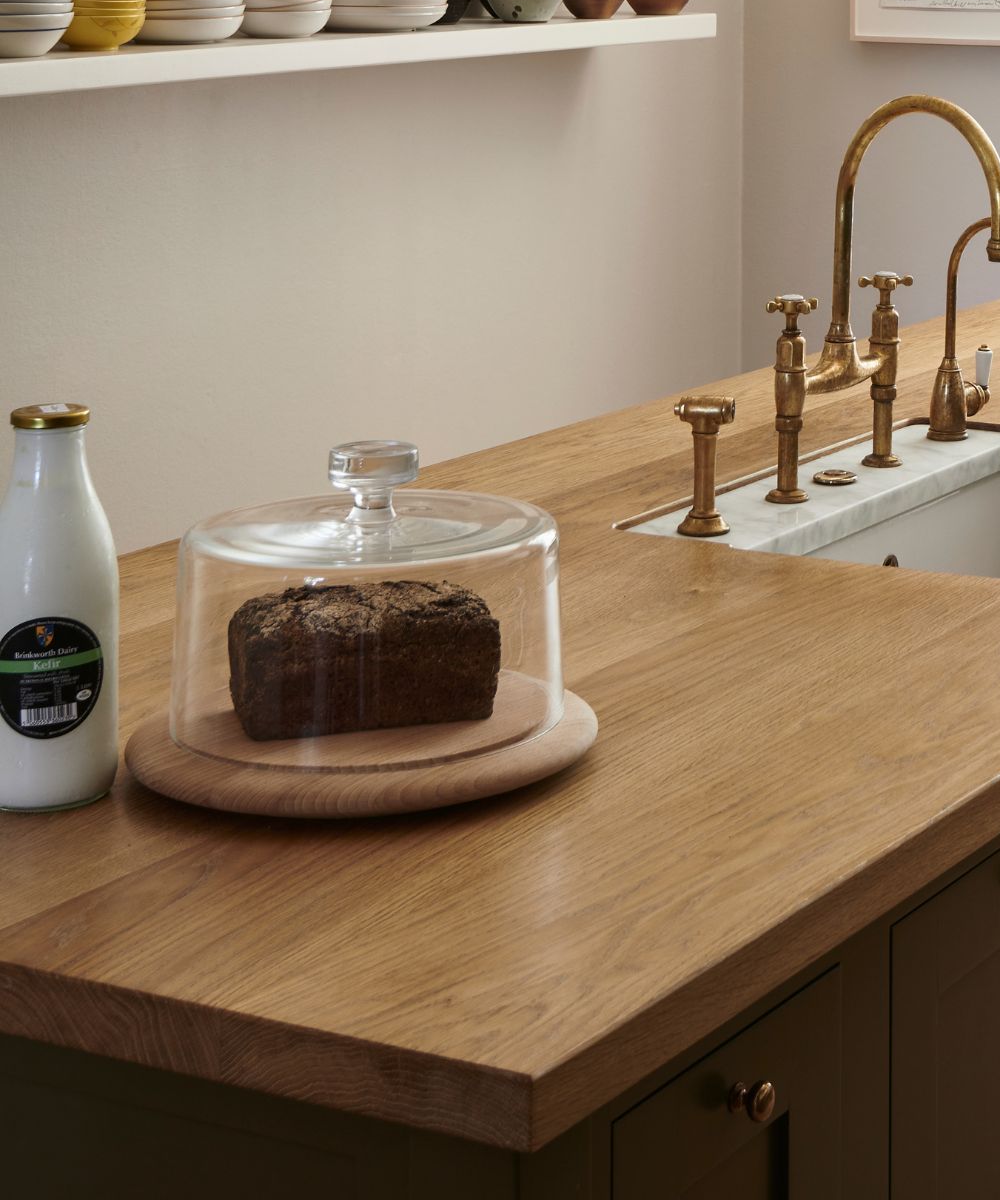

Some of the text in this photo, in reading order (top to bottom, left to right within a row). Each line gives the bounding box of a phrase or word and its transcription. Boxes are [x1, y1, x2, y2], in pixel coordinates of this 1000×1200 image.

[14, 645, 79, 660] Brinkworth Dairy
[32, 658, 62, 671] Kefir
